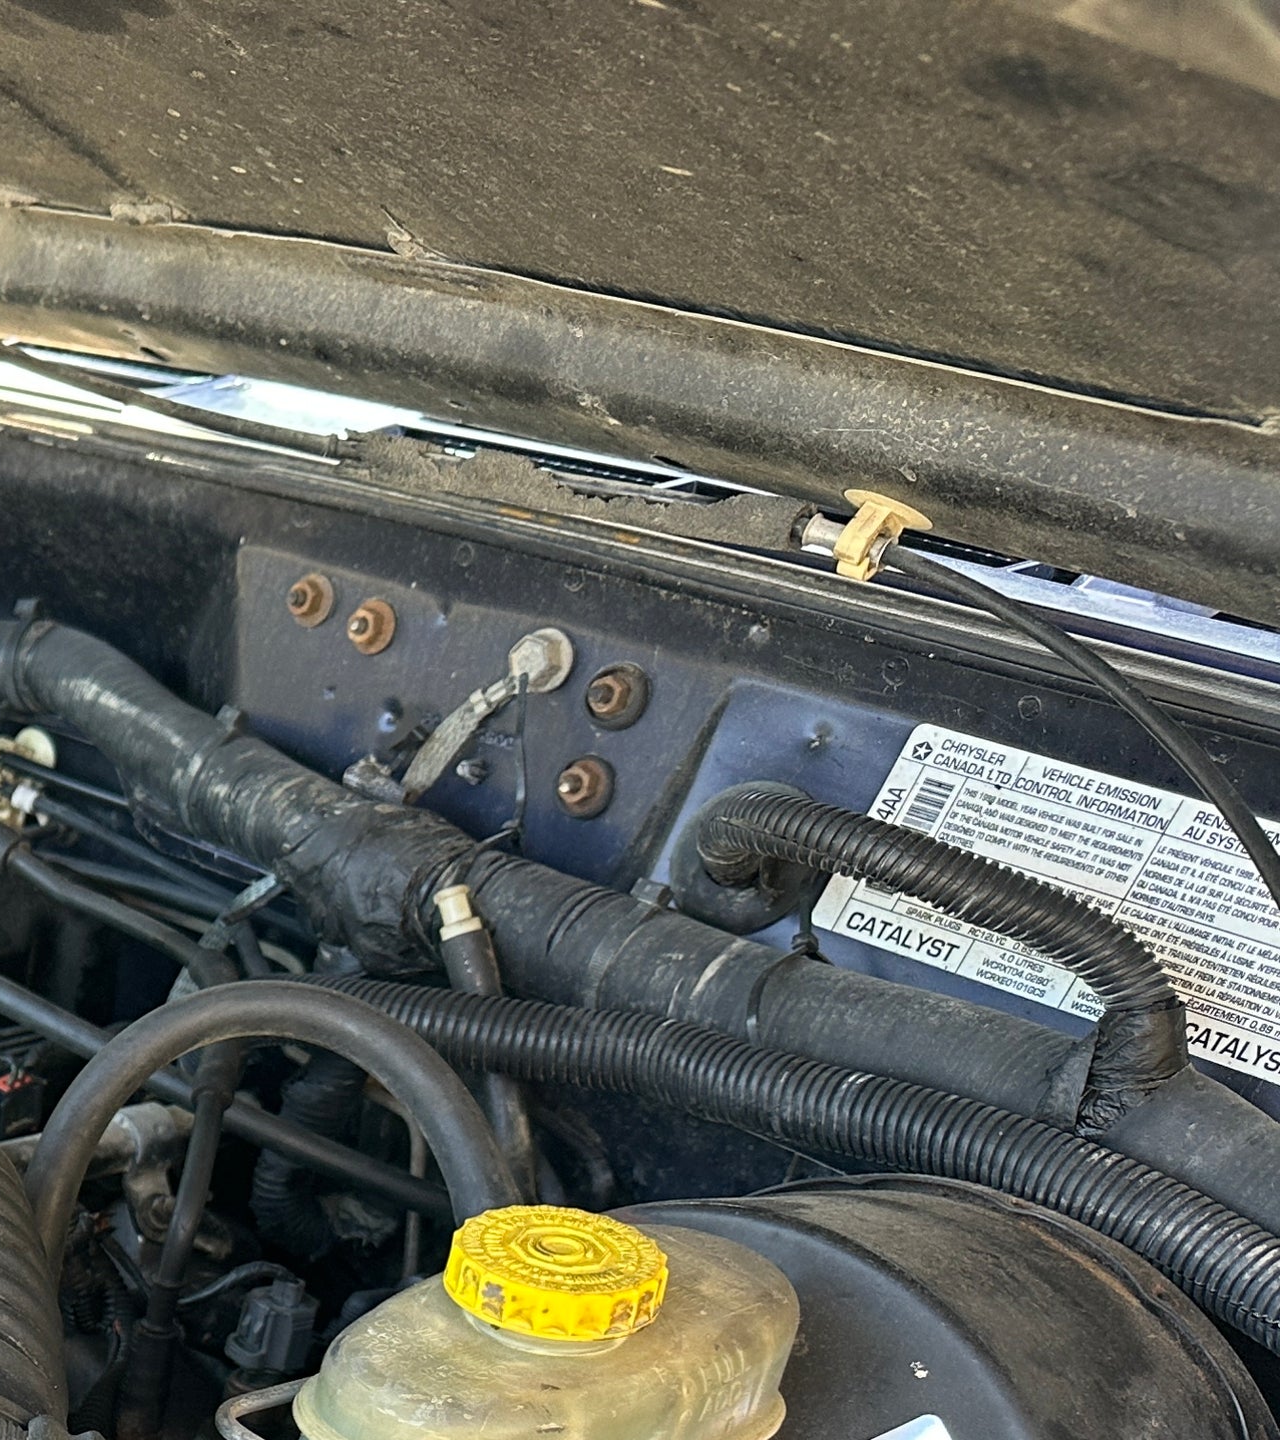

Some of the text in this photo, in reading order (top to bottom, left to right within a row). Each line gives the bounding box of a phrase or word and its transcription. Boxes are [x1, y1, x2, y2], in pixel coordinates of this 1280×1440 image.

[933, 753, 984, 777] CANADA
[941, 739, 1005, 765] CHRYSLER
[876, 788, 906, 819] 4AA
[1014, 777, 1168, 829] CONTROL INFORMATION
[1042, 766, 1161, 809] VEHICLE EMISSION
[983, 807, 998, 817] AND
[998, 812, 1015, 822] WAS
[1014, 817, 1048, 832] DESIGNED
[1048, 826, 1058, 835] TO
[1057, 829, 1077, 840] MEET
[1077, 835, 1090, 845] THE
[996, 797, 1017, 810] MODEL
[1020, 805, 1037, 815] YEAR
[1038, 810, 1064, 823] VEHICLE
[1064, 818, 1081, 828] WAS
[1081, 822, 1101, 833] BUILT
[1101, 828, 1116, 838] FOR
[1115, 833, 1133, 844] SALE
[1133, 838, 1143, 847] IN
[1182, 826, 1206, 840] AU
[959, 813, 972, 824] THE
[971, 817, 998, 831] CANADA
[999, 826, 1023, 838] MOTOR
[1023, 834, 1050, 847] VEHICLE
[1049, 841, 1075, 853] SAFETY
[1099, 856, 1116, 867] WAS
[1115, 861, 1132, 871] NOT
[984, 834, 1012, 847] COMPLY
[1012, 843, 1030, 853] WITH
[1030, 847, 1043, 857] THE
[1094, 867, 1104, 875] OF
[1104, 870, 1128, 882] OTHER
[1156, 845, 1167, 854] LE
[1142, 869, 1173, 883] NORMES
[1173, 878, 1184, 887] DE
[1184, 881, 1194, 890] LA
[1207, 888, 1223, 898] SUR
[1222, 892, 1233, 902] LA
[1150, 857, 1179, 871] CANADA
[1179, 865, 1191, 874] ET
[1244, 885, 1257, 895] DE
[1130, 890, 1160, 905] NORMES
[1201, 899, 1217, 910] PAS
[846, 912, 959, 960] CATALYST
[905, 906, 933, 921] SPARK
[934, 916, 962, 931] PLUGS
[967, 926, 1006, 945] RC12LYC
[1119, 905, 1130, 914] LE
[1129, 908, 1157, 923] CALAGE
[1156, 917, 1167, 926] DE
[1211, 934, 1234, 948] INITIAL
[1235, 941, 1247, 951] ET
[1246, 945, 1257, 954] LE
[1150, 929, 1166, 939] ONT
[999, 952, 1044, 973] 4.0 LITRES
[1155, 944, 1167, 954] DE
[1167, 948, 1200, 964] TRAVAUX
[1183, 967, 1194, 976] LE
[1193, 970, 1216, 983] FREIN
[1215, 977, 1227, 986] DE
[1184, 998, 1248, 1024] ÉCARTEMENT
[1193, 984, 1206, 993] OU
[1205, 987, 1216, 997] LA
[1261, 1006, 1274, 1016] DU
[1185, 1022, 1280, 1074] CATALYS
